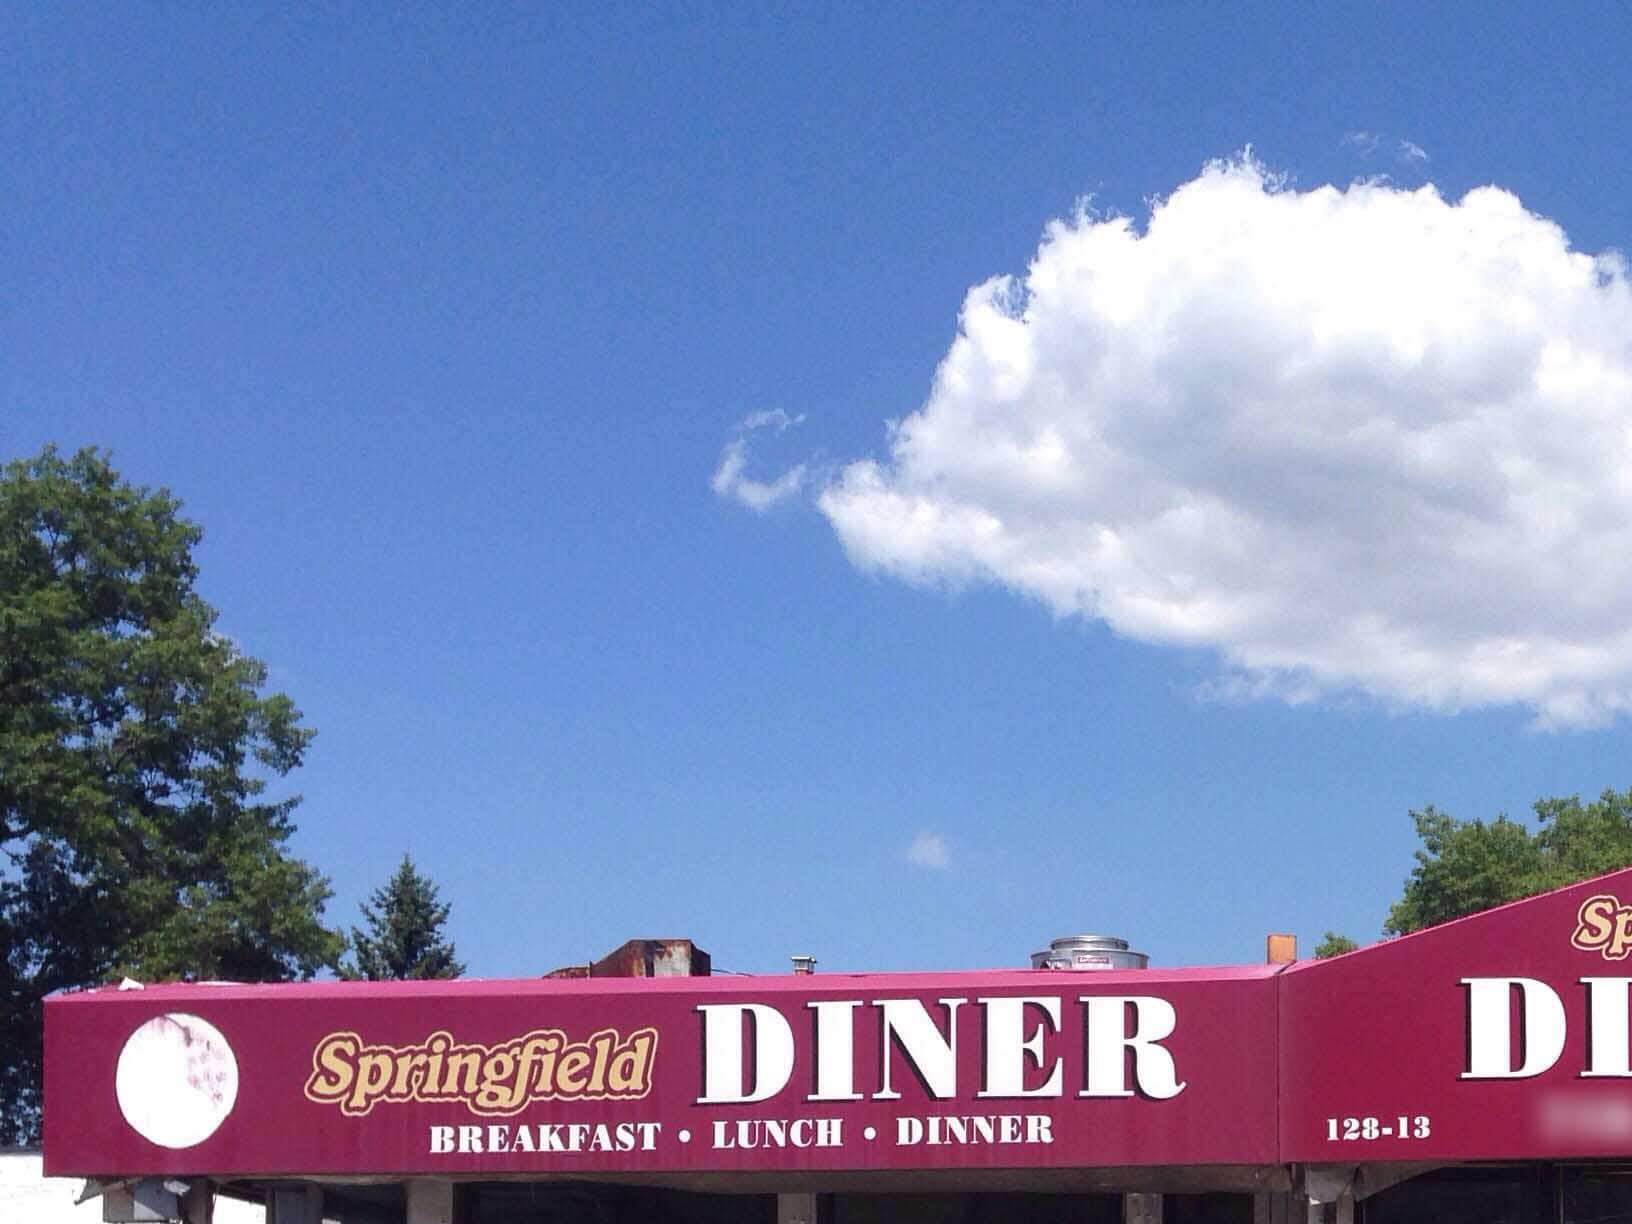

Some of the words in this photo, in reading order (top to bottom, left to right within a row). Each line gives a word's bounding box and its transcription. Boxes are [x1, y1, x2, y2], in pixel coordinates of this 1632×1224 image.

[306, 1029, 659, 1115] Springfield
[695, 996, 1187, 1105] DINER
[429, 1123, 662, 1154] BREAKFAST
[712, 1118, 843, 1149] LUNCH
[896, 1115, 1054, 1146] DINNER
[1327, 1116, 1432, 1142] 128-13
